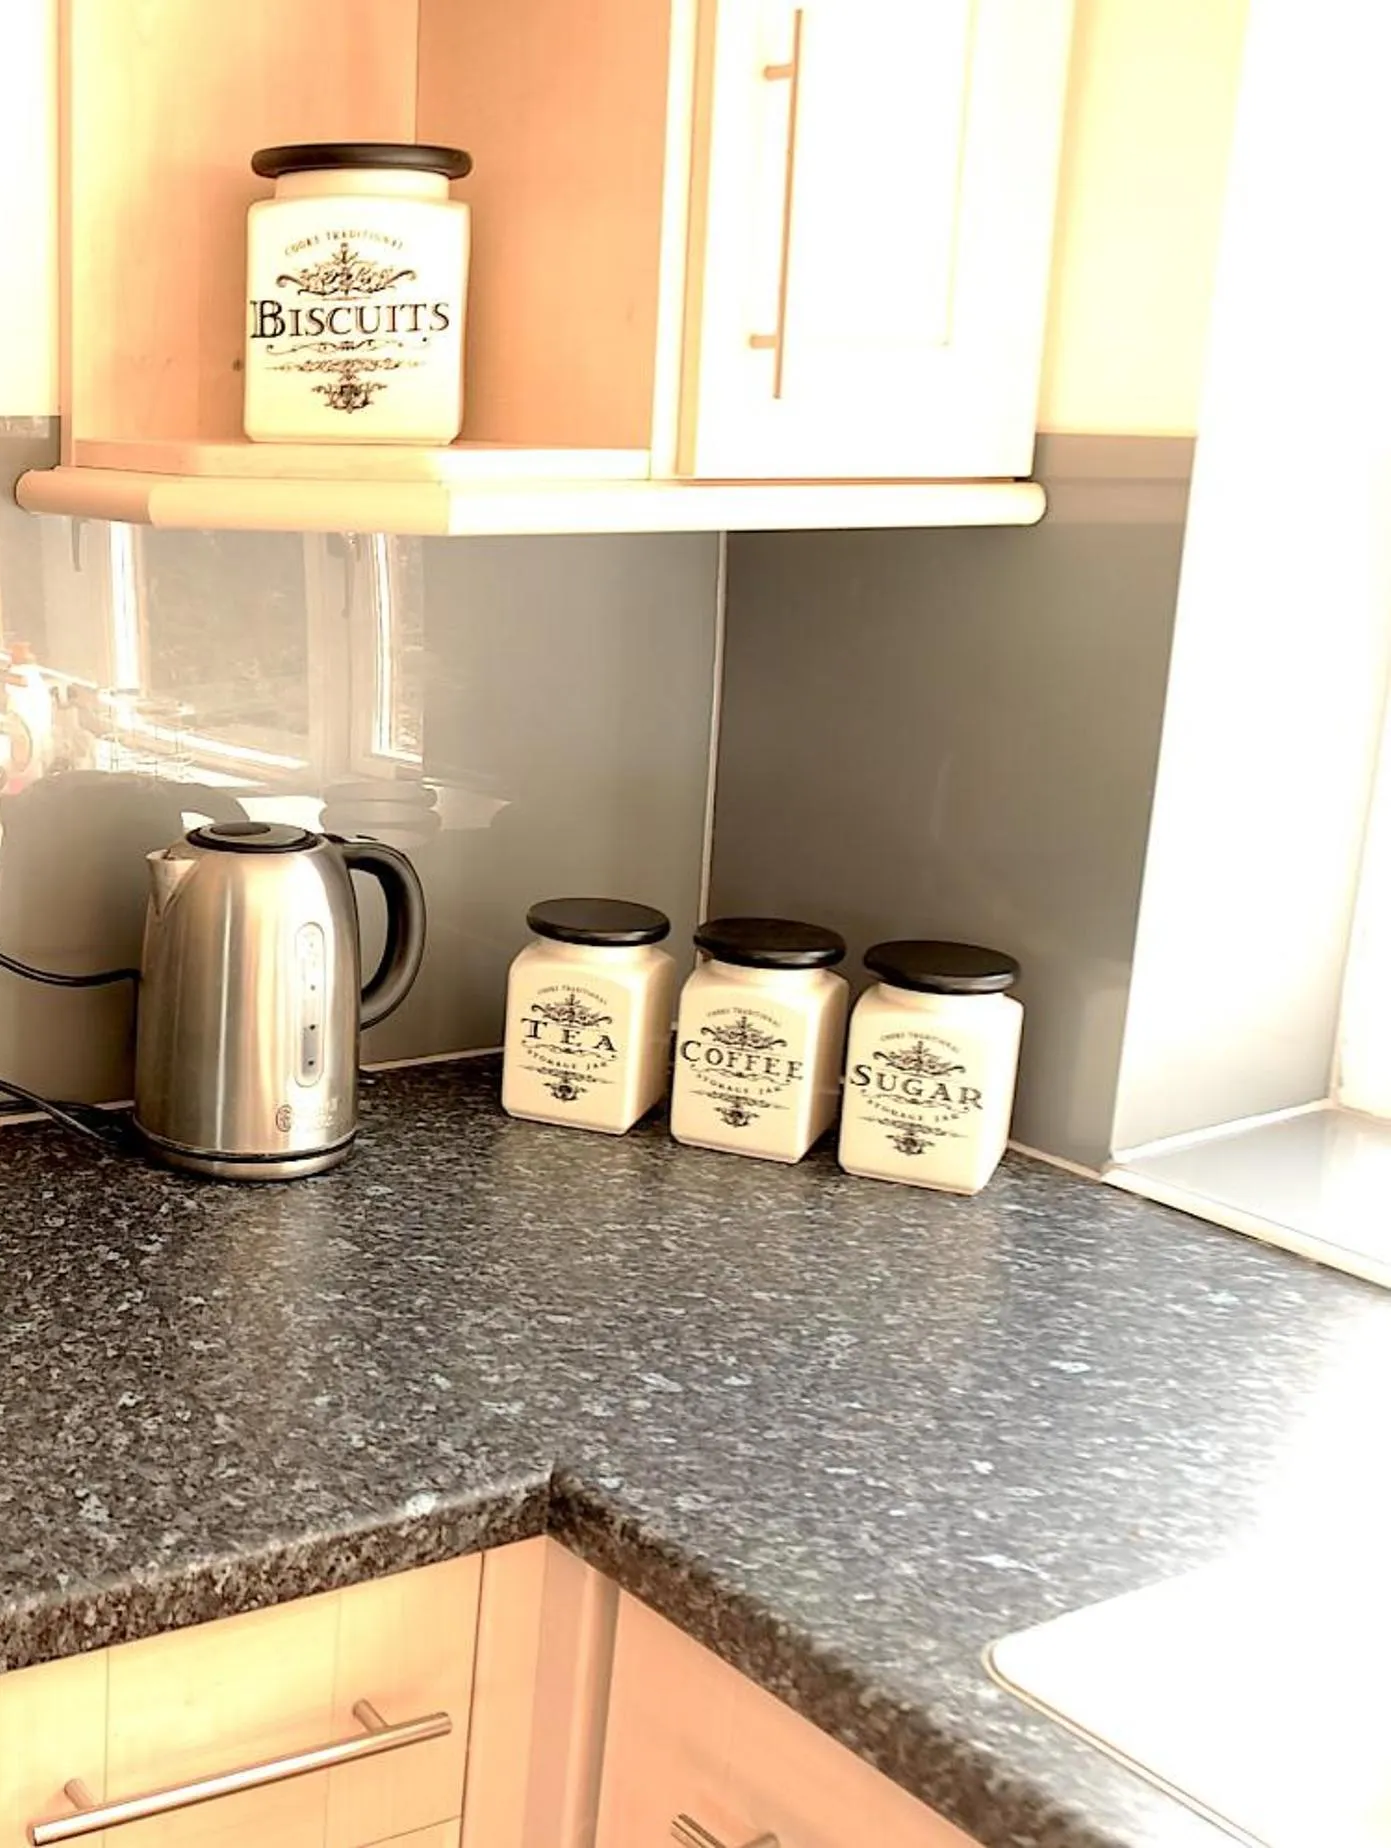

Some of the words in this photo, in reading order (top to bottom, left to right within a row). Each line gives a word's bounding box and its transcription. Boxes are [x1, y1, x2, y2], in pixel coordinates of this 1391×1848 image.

[249, 299, 451, 339] BISCUITS
[520, 1017, 618, 1052] TEA
[680, 1039, 804, 1080] COFFEE
[850, 1064, 984, 1110] SUGAR
